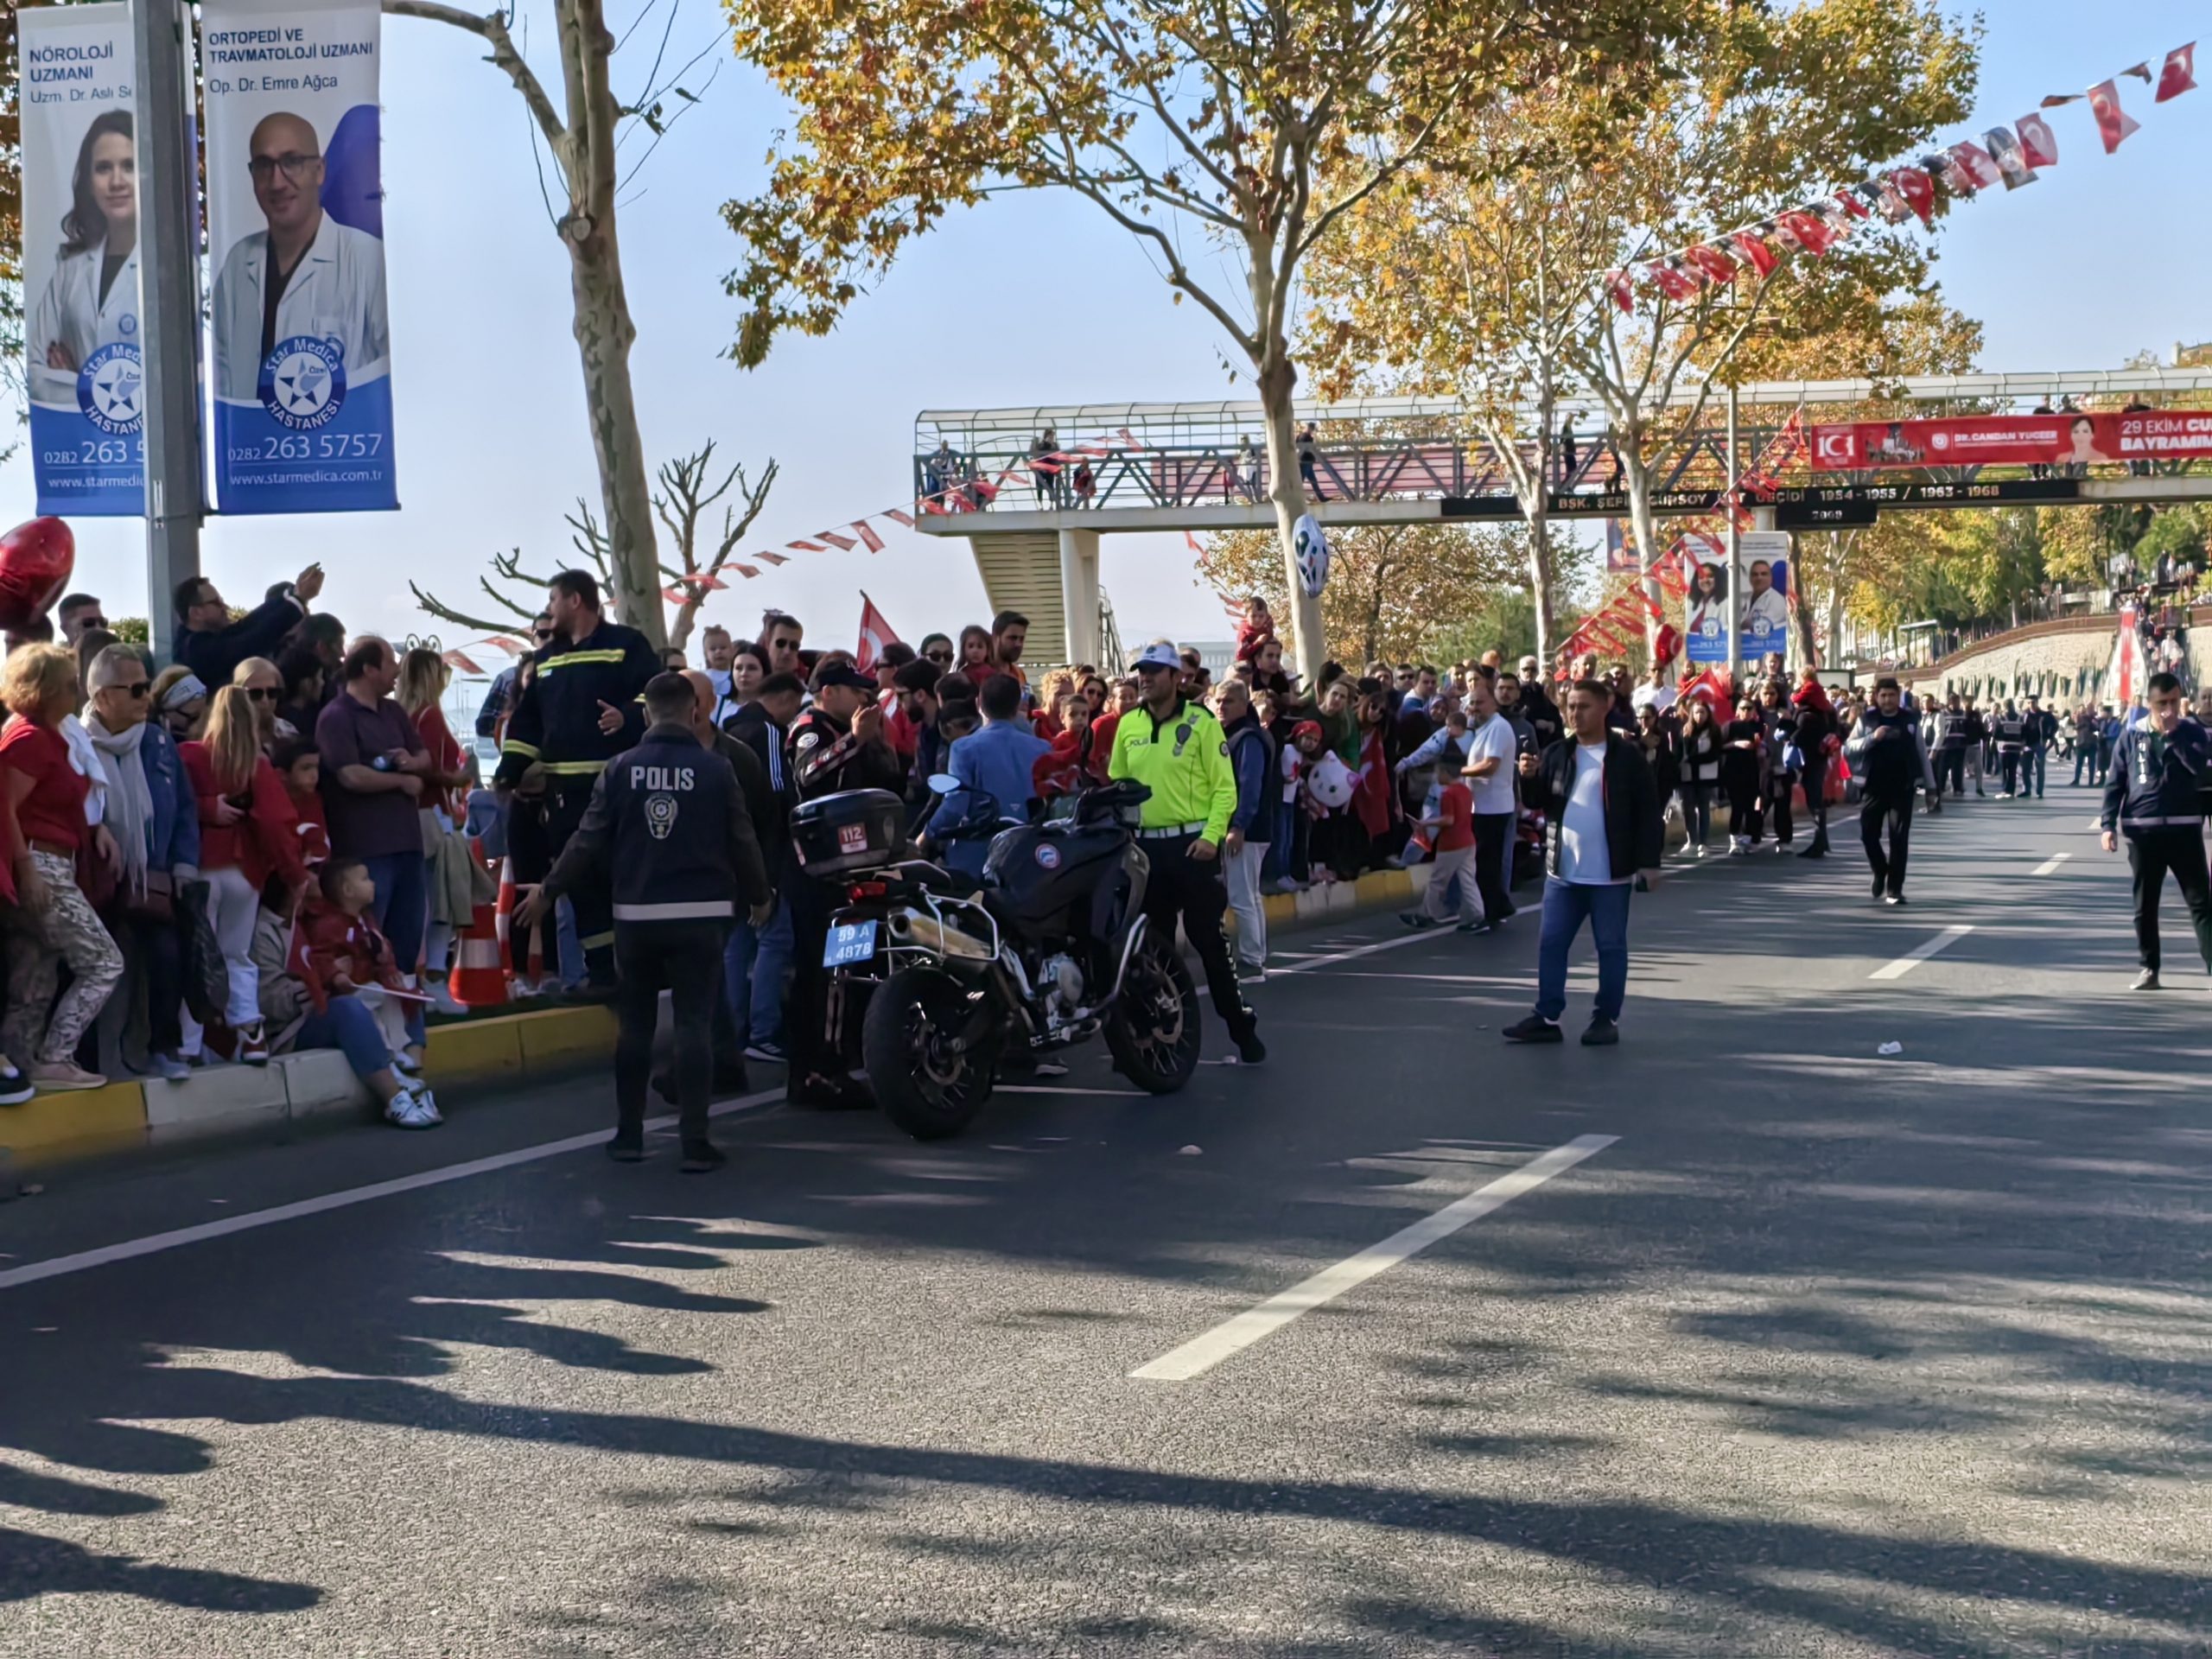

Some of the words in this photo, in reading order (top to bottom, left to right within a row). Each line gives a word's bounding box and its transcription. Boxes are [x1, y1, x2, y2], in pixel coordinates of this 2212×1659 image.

[209, 27, 282, 45] ORTOPEDİ
[285, 29, 303, 41] VE
[29, 40, 114, 63] NÖROLOJİ
[209, 42, 317, 64] TRAVMATOLOJİ
[321, 41, 373, 58] UZMANI
[30, 66, 93, 83] UZMANI
[91, 86, 114, 100] Aslı
[209, 79, 234, 96] Op.
[238, 77, 258, 92] Dr.
[262, 76, 299, 91] Emre
[302, 74, 338, 92] Ağca
[84, 351, 108, 379] Star
[111, 344, 141, 364] Med
[265, 346, 289, 374] Star
[294, 338, 339, 372] Medica
[2121, 420, 2142, 435] 29
[2145, 416, 2183, 435] EKİM
[2186, 417, 2212, 432] CU
[44, 451, 79, 464] 0282
[81, 440, 128, 463] 263
[228, 447, 261, 462] 0282
[264, 435, 311, 460] 263
[319, 433, 383, 458] 5757
[2120, 434, 2212, 451] BAYRAMIN
[230, 469, 382, 486] www.starmedica.com.tr
[1865, 487, 1897, 500] 1955
[630, 765, 695, 791] POLIS
[842, 826, 863, 843] 112
[837, 925, 855, 943] 59
[859, 924, 869, 938] A
